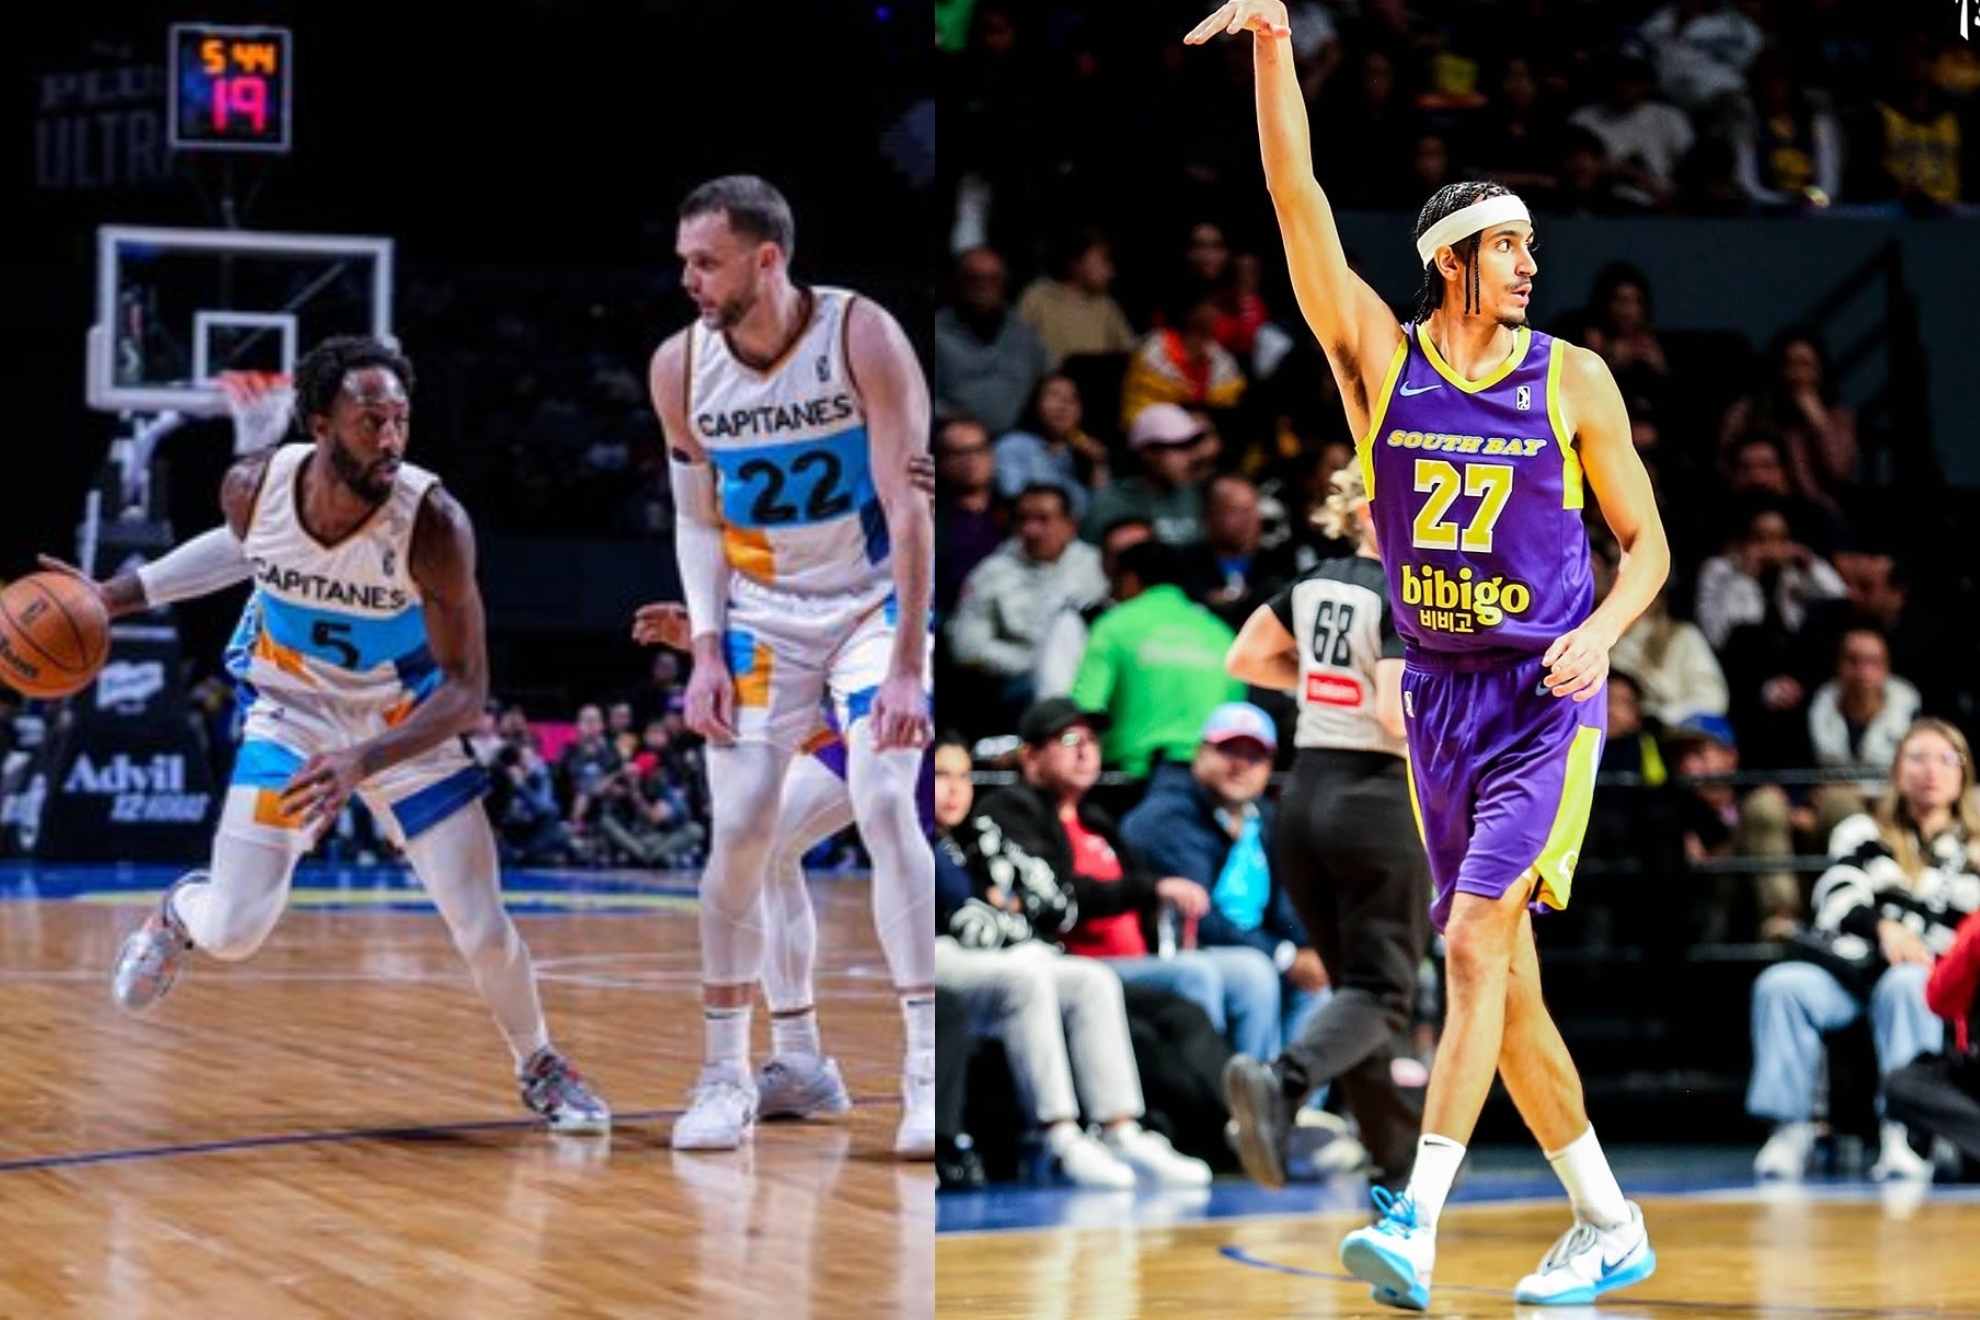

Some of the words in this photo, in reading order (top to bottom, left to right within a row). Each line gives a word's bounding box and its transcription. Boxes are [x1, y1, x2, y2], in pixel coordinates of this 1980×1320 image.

[212, 76, 268, 134] 19
[698, 395, 850, 437] CAPITANES
[1387, 430, 1479, 455] SOUTH
[1482, 435, 1547, 457] BAY
[737, 450, 851, 524] 22
[1413, 458, 1514, 553] 27
[1402, 565, 1530, 626] bibigo
[1419, 610, 1475, 633] 비비고
[311, 621, 359, 672] 5
[1313, 600, 1354, 667] 68
[64, 754, 184, 793] Advil
